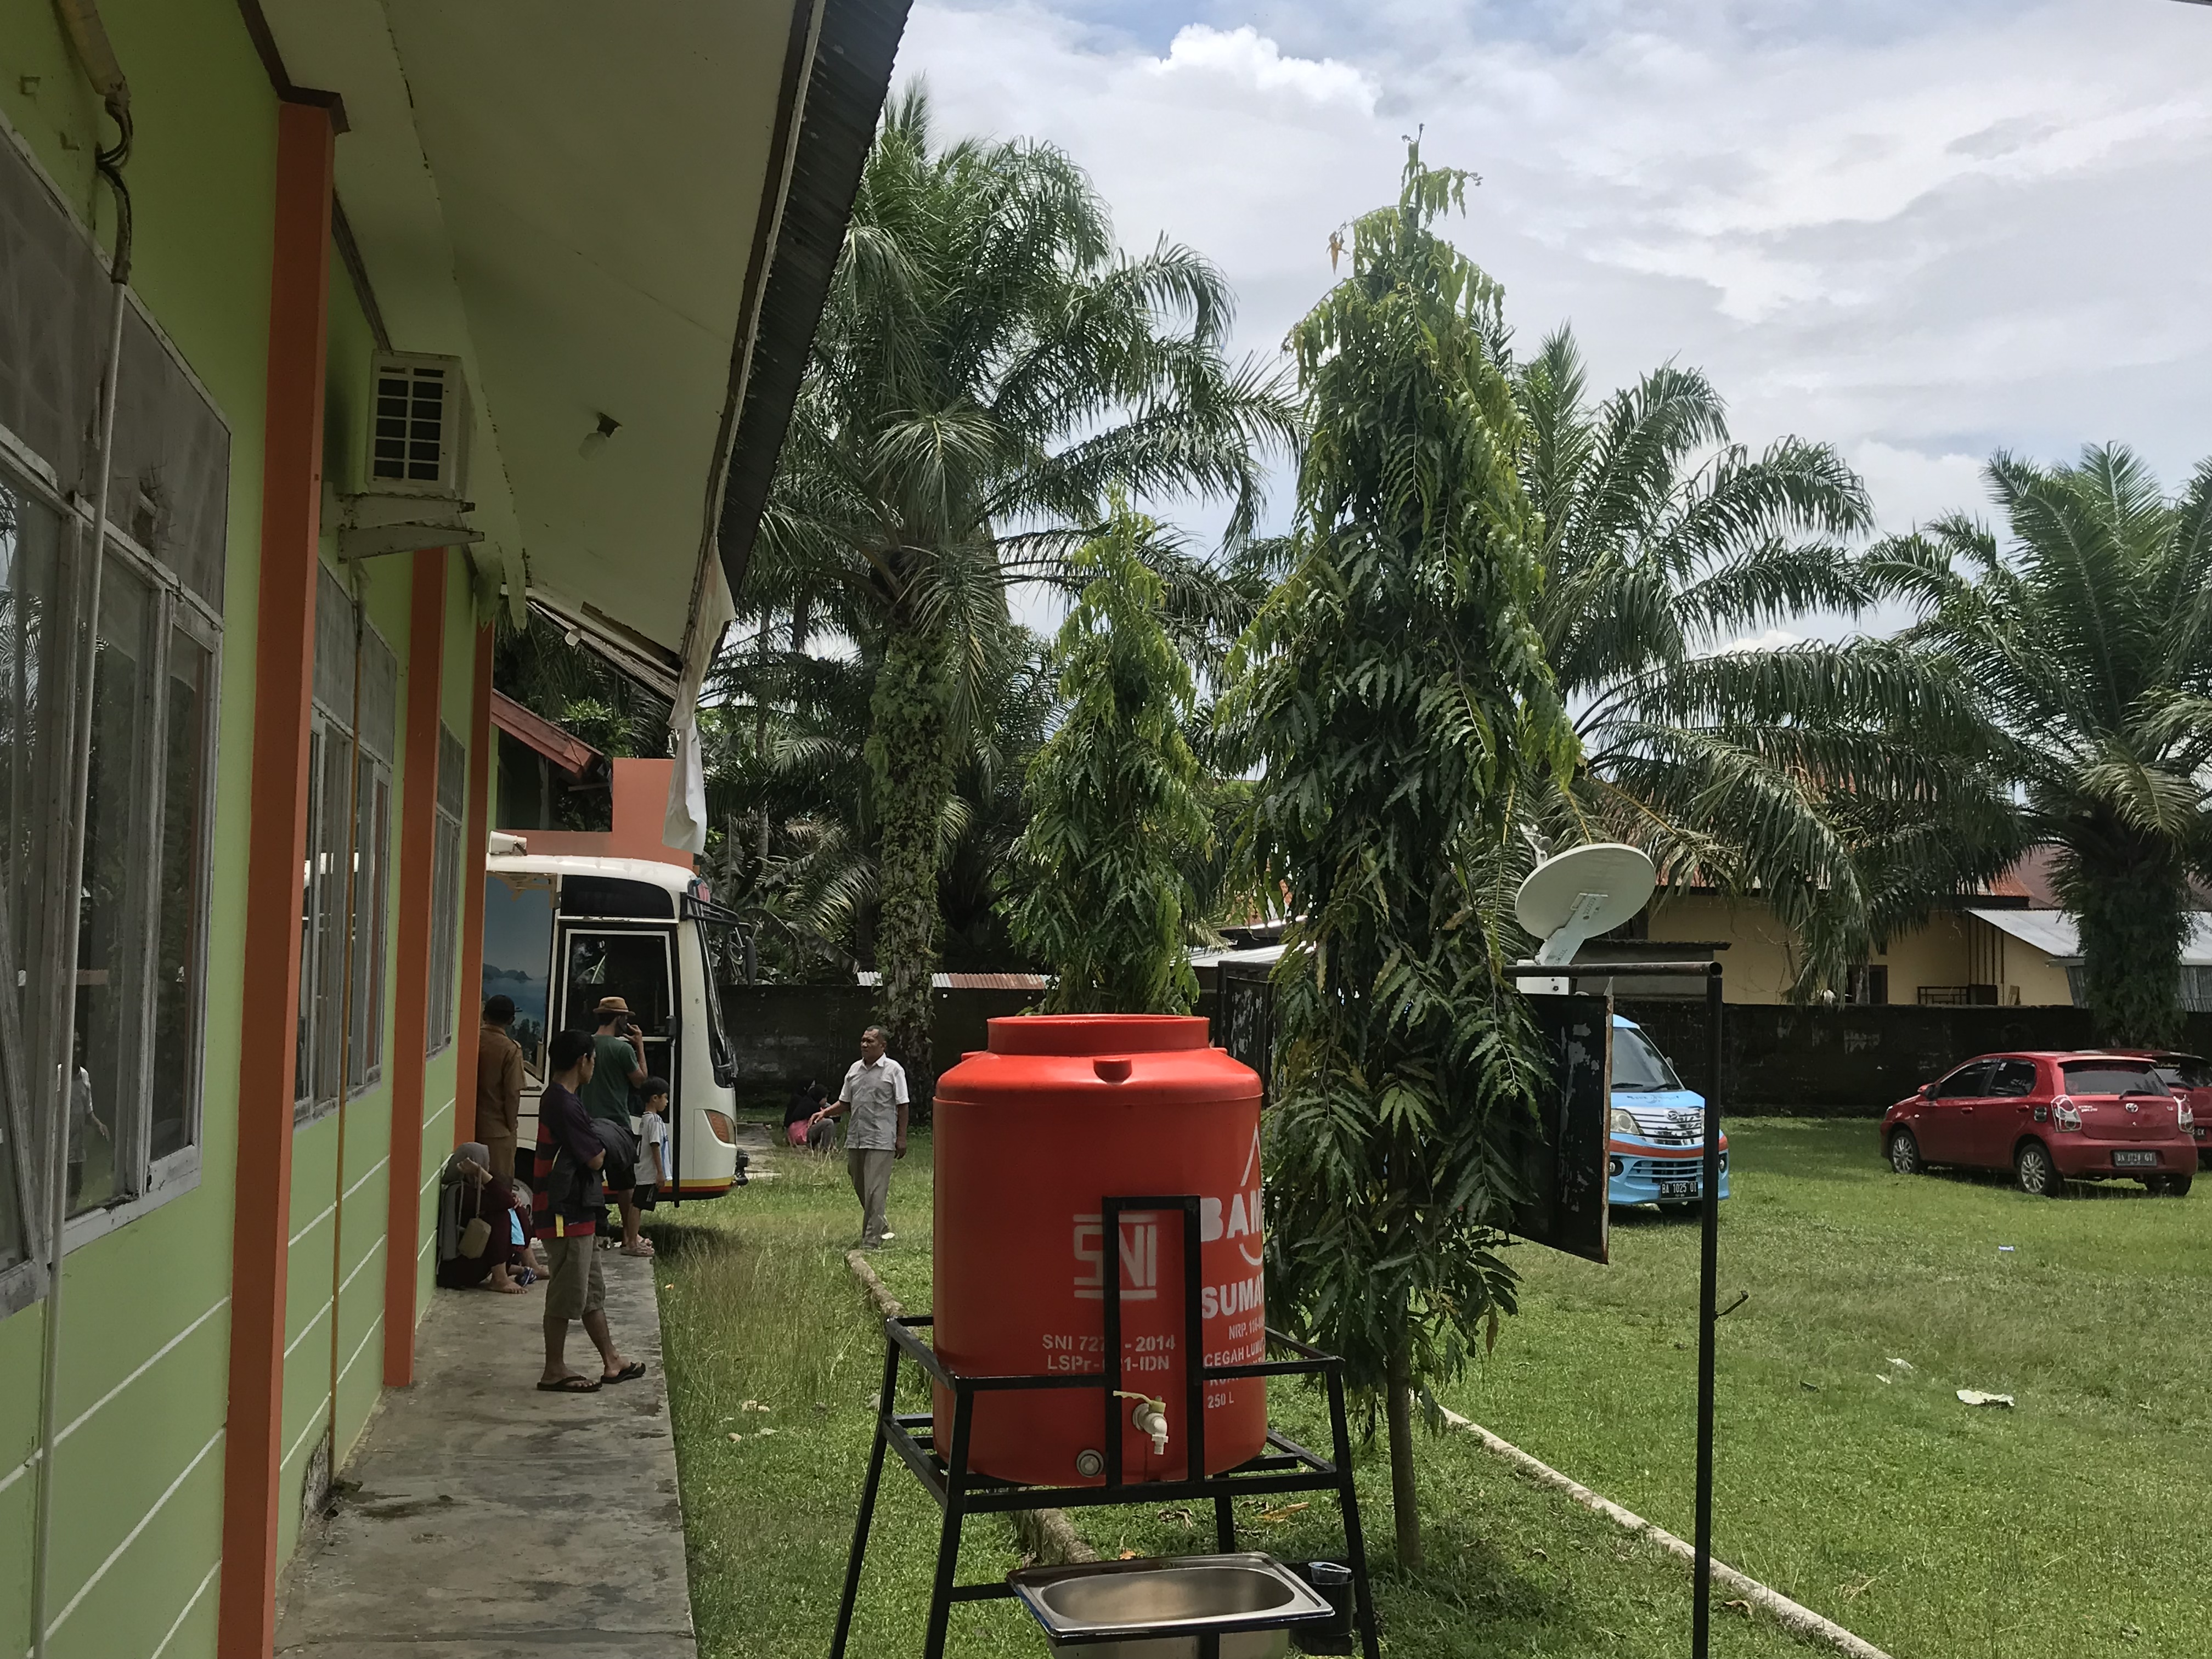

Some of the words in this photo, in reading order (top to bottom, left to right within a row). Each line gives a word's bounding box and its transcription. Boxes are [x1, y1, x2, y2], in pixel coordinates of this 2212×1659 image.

[1662, 1183, 1669, 1194] BA
[1673, 1183, 1687, 1193] 1025
[1074, 1224, 1156, 1288] SNI
[1043, 1334, 1072, 1350] SNI
[1135, 1335, 1175, 1352] 2014
[1204, 1346, 1244, 1367] CEGAH
[1207, 1393, 1226, 1408] 250
[1229, 1392, 1234, 1403] L
